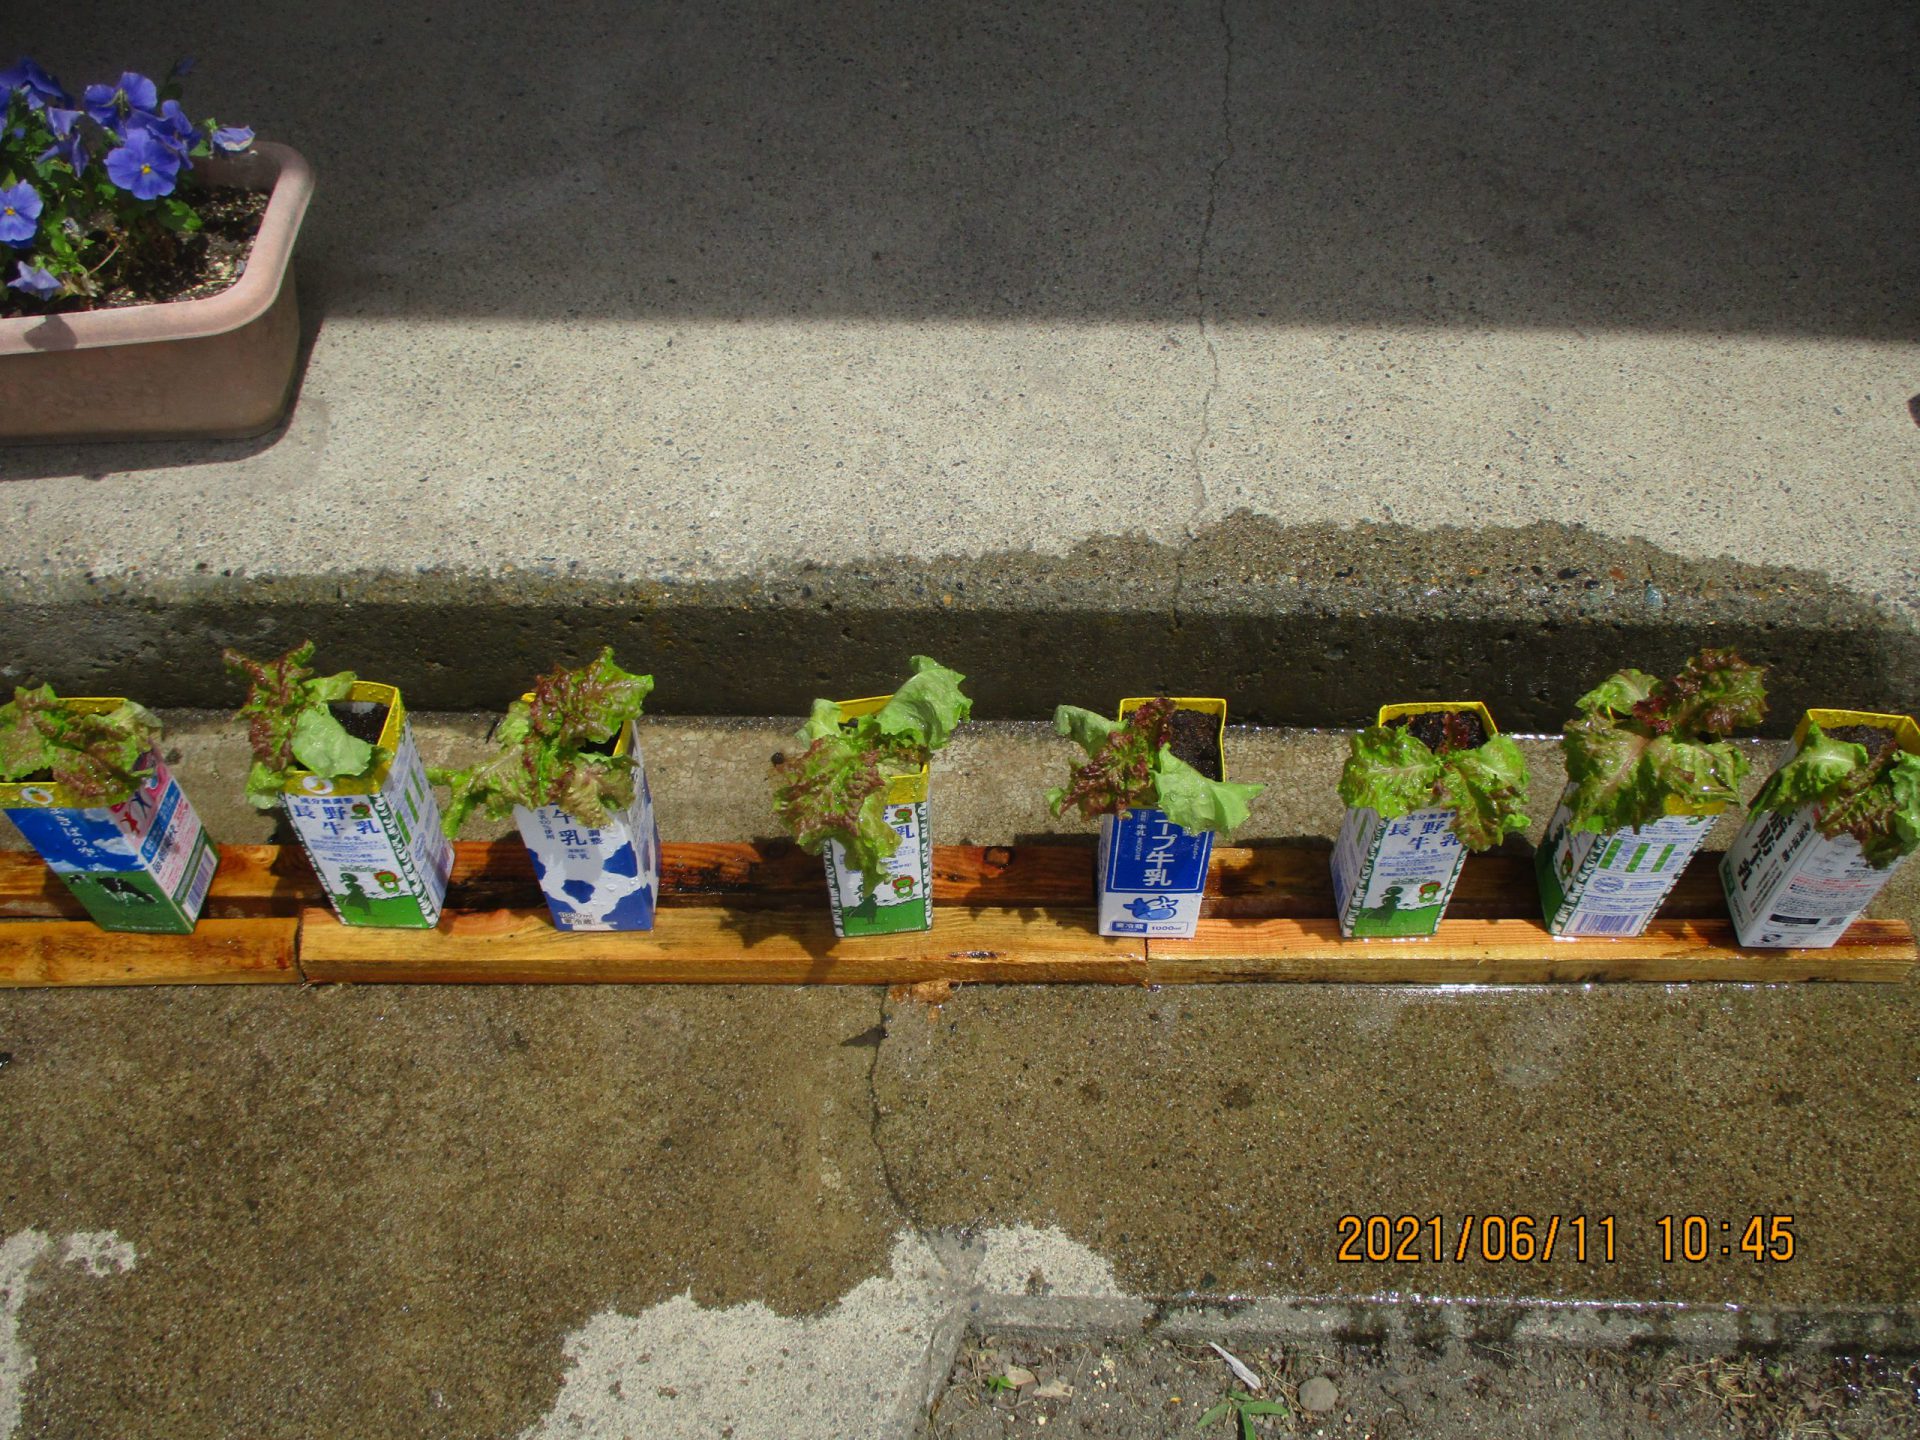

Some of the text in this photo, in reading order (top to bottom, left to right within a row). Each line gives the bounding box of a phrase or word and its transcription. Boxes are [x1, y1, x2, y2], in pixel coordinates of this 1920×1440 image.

[294, 804, 347, 820] 長野
[323, 820, 380, 835] 牛乳
[1388, 820, 1446, 837] 長野
